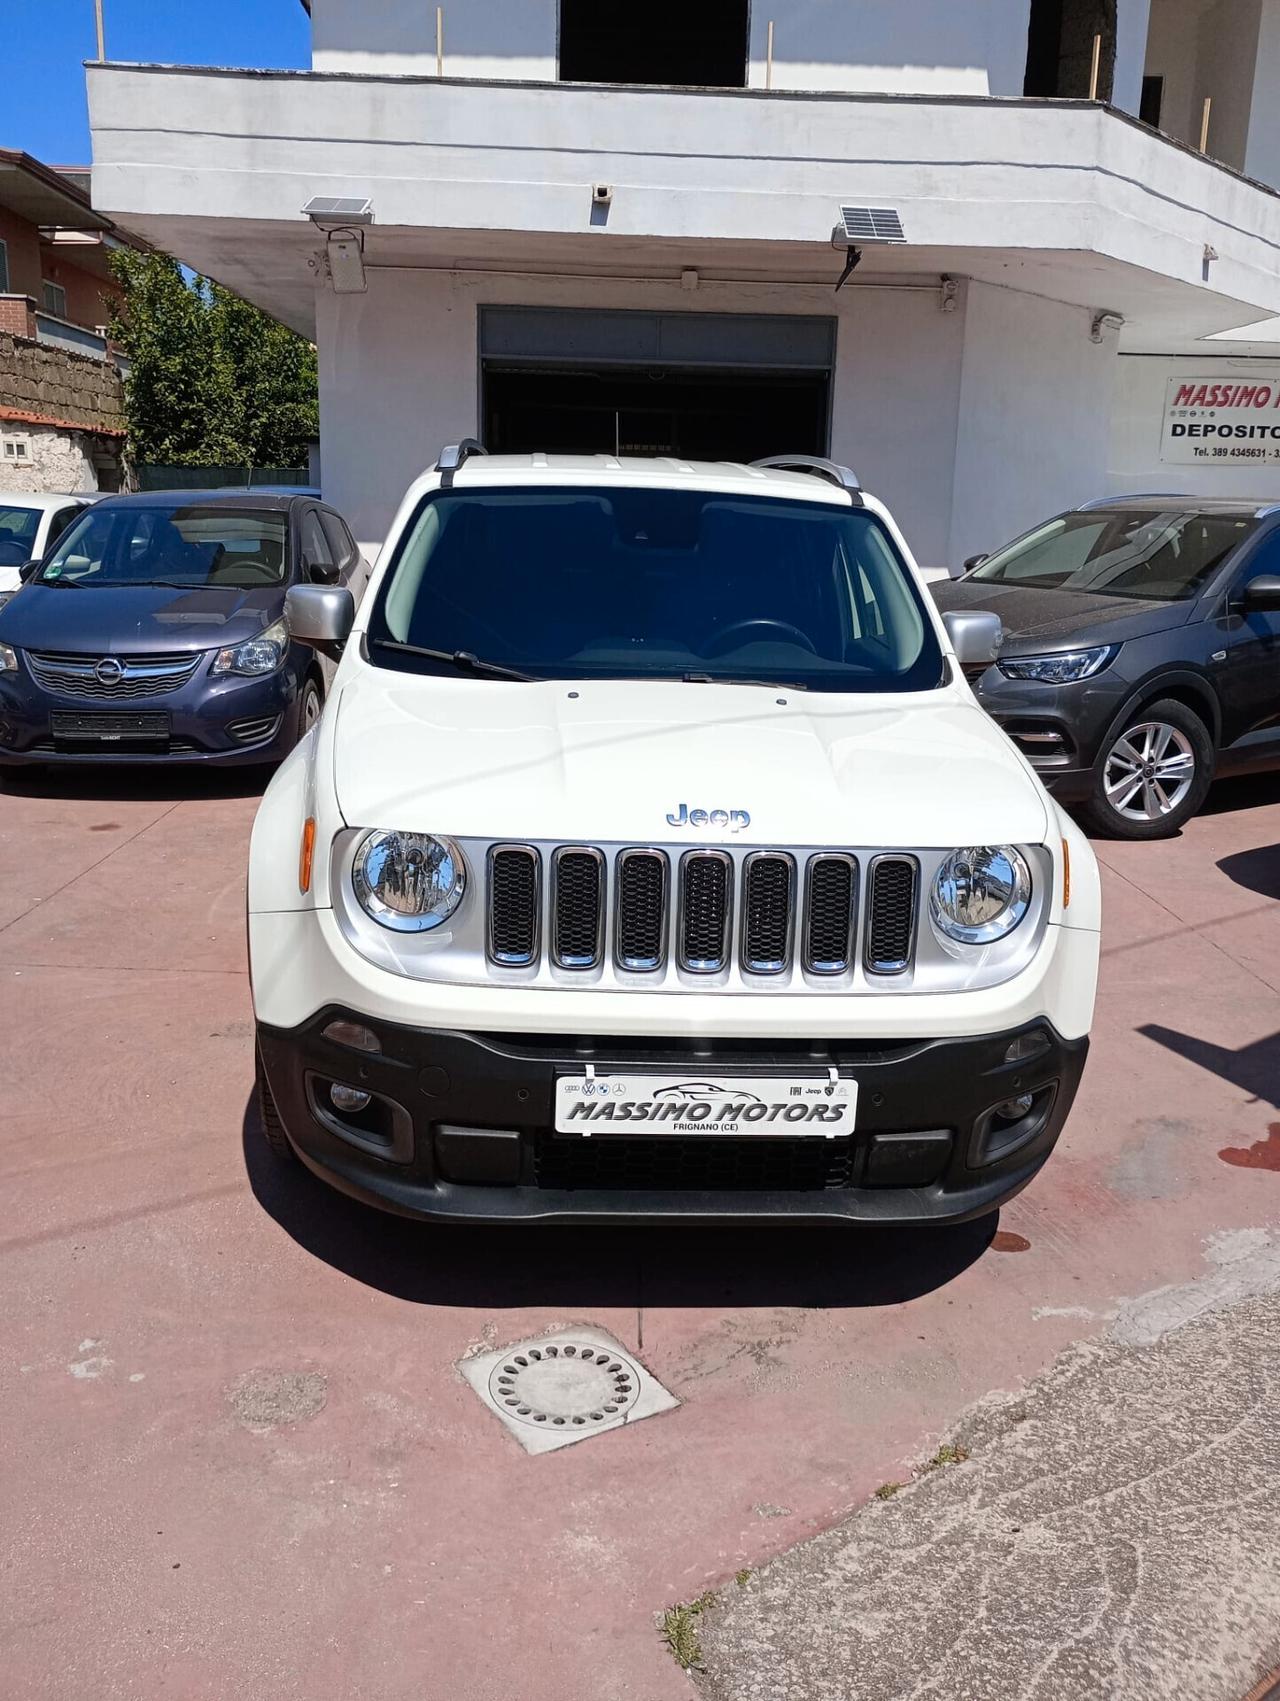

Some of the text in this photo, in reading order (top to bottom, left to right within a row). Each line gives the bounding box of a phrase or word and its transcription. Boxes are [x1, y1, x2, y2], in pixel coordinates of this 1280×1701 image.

[1173, 384, 1271, 408] MASSIMO
[1194, 447, 1209, 457] Tel.
[1212, 447, 1228, 457] 389
[1230, 448, 1266, 458] 4345631
[666, 803, 751, 833] Jeep
[566, 1101, 847, 1122] MASSIMO MOTORS
[673, 1123, 739, 1132] FRIGNANO (CE)
